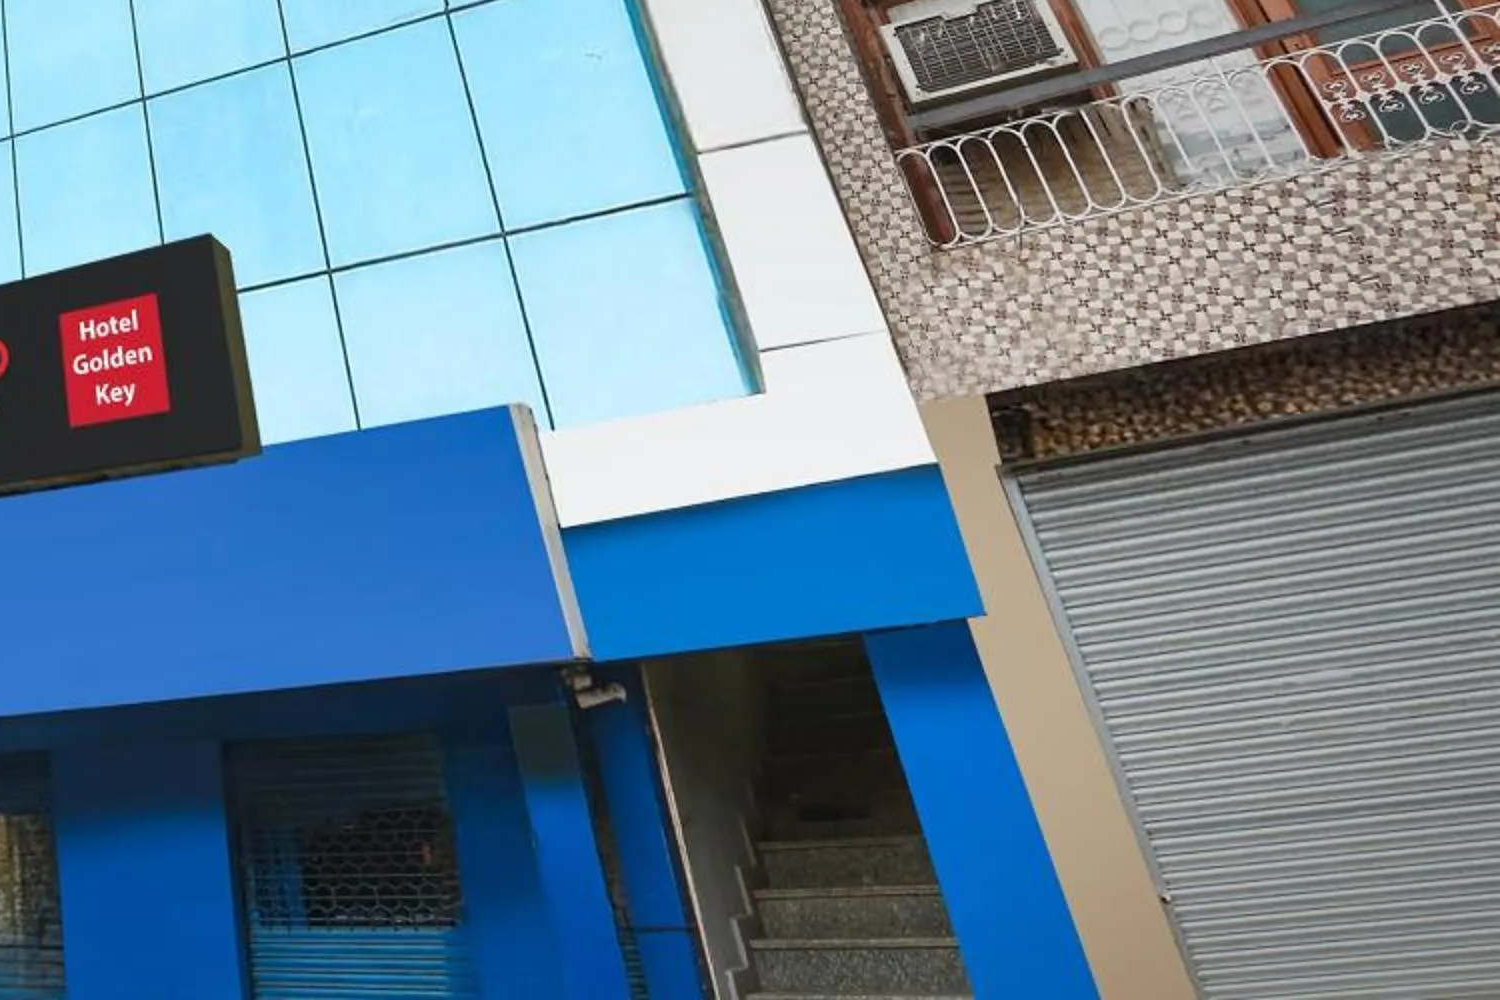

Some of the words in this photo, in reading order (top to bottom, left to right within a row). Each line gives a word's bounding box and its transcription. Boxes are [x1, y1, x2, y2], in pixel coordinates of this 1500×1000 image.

[79, 308, 139, 341] Hotel
[73, 345, 153, 375] Golden
[95, 383, 135, 407] Key
